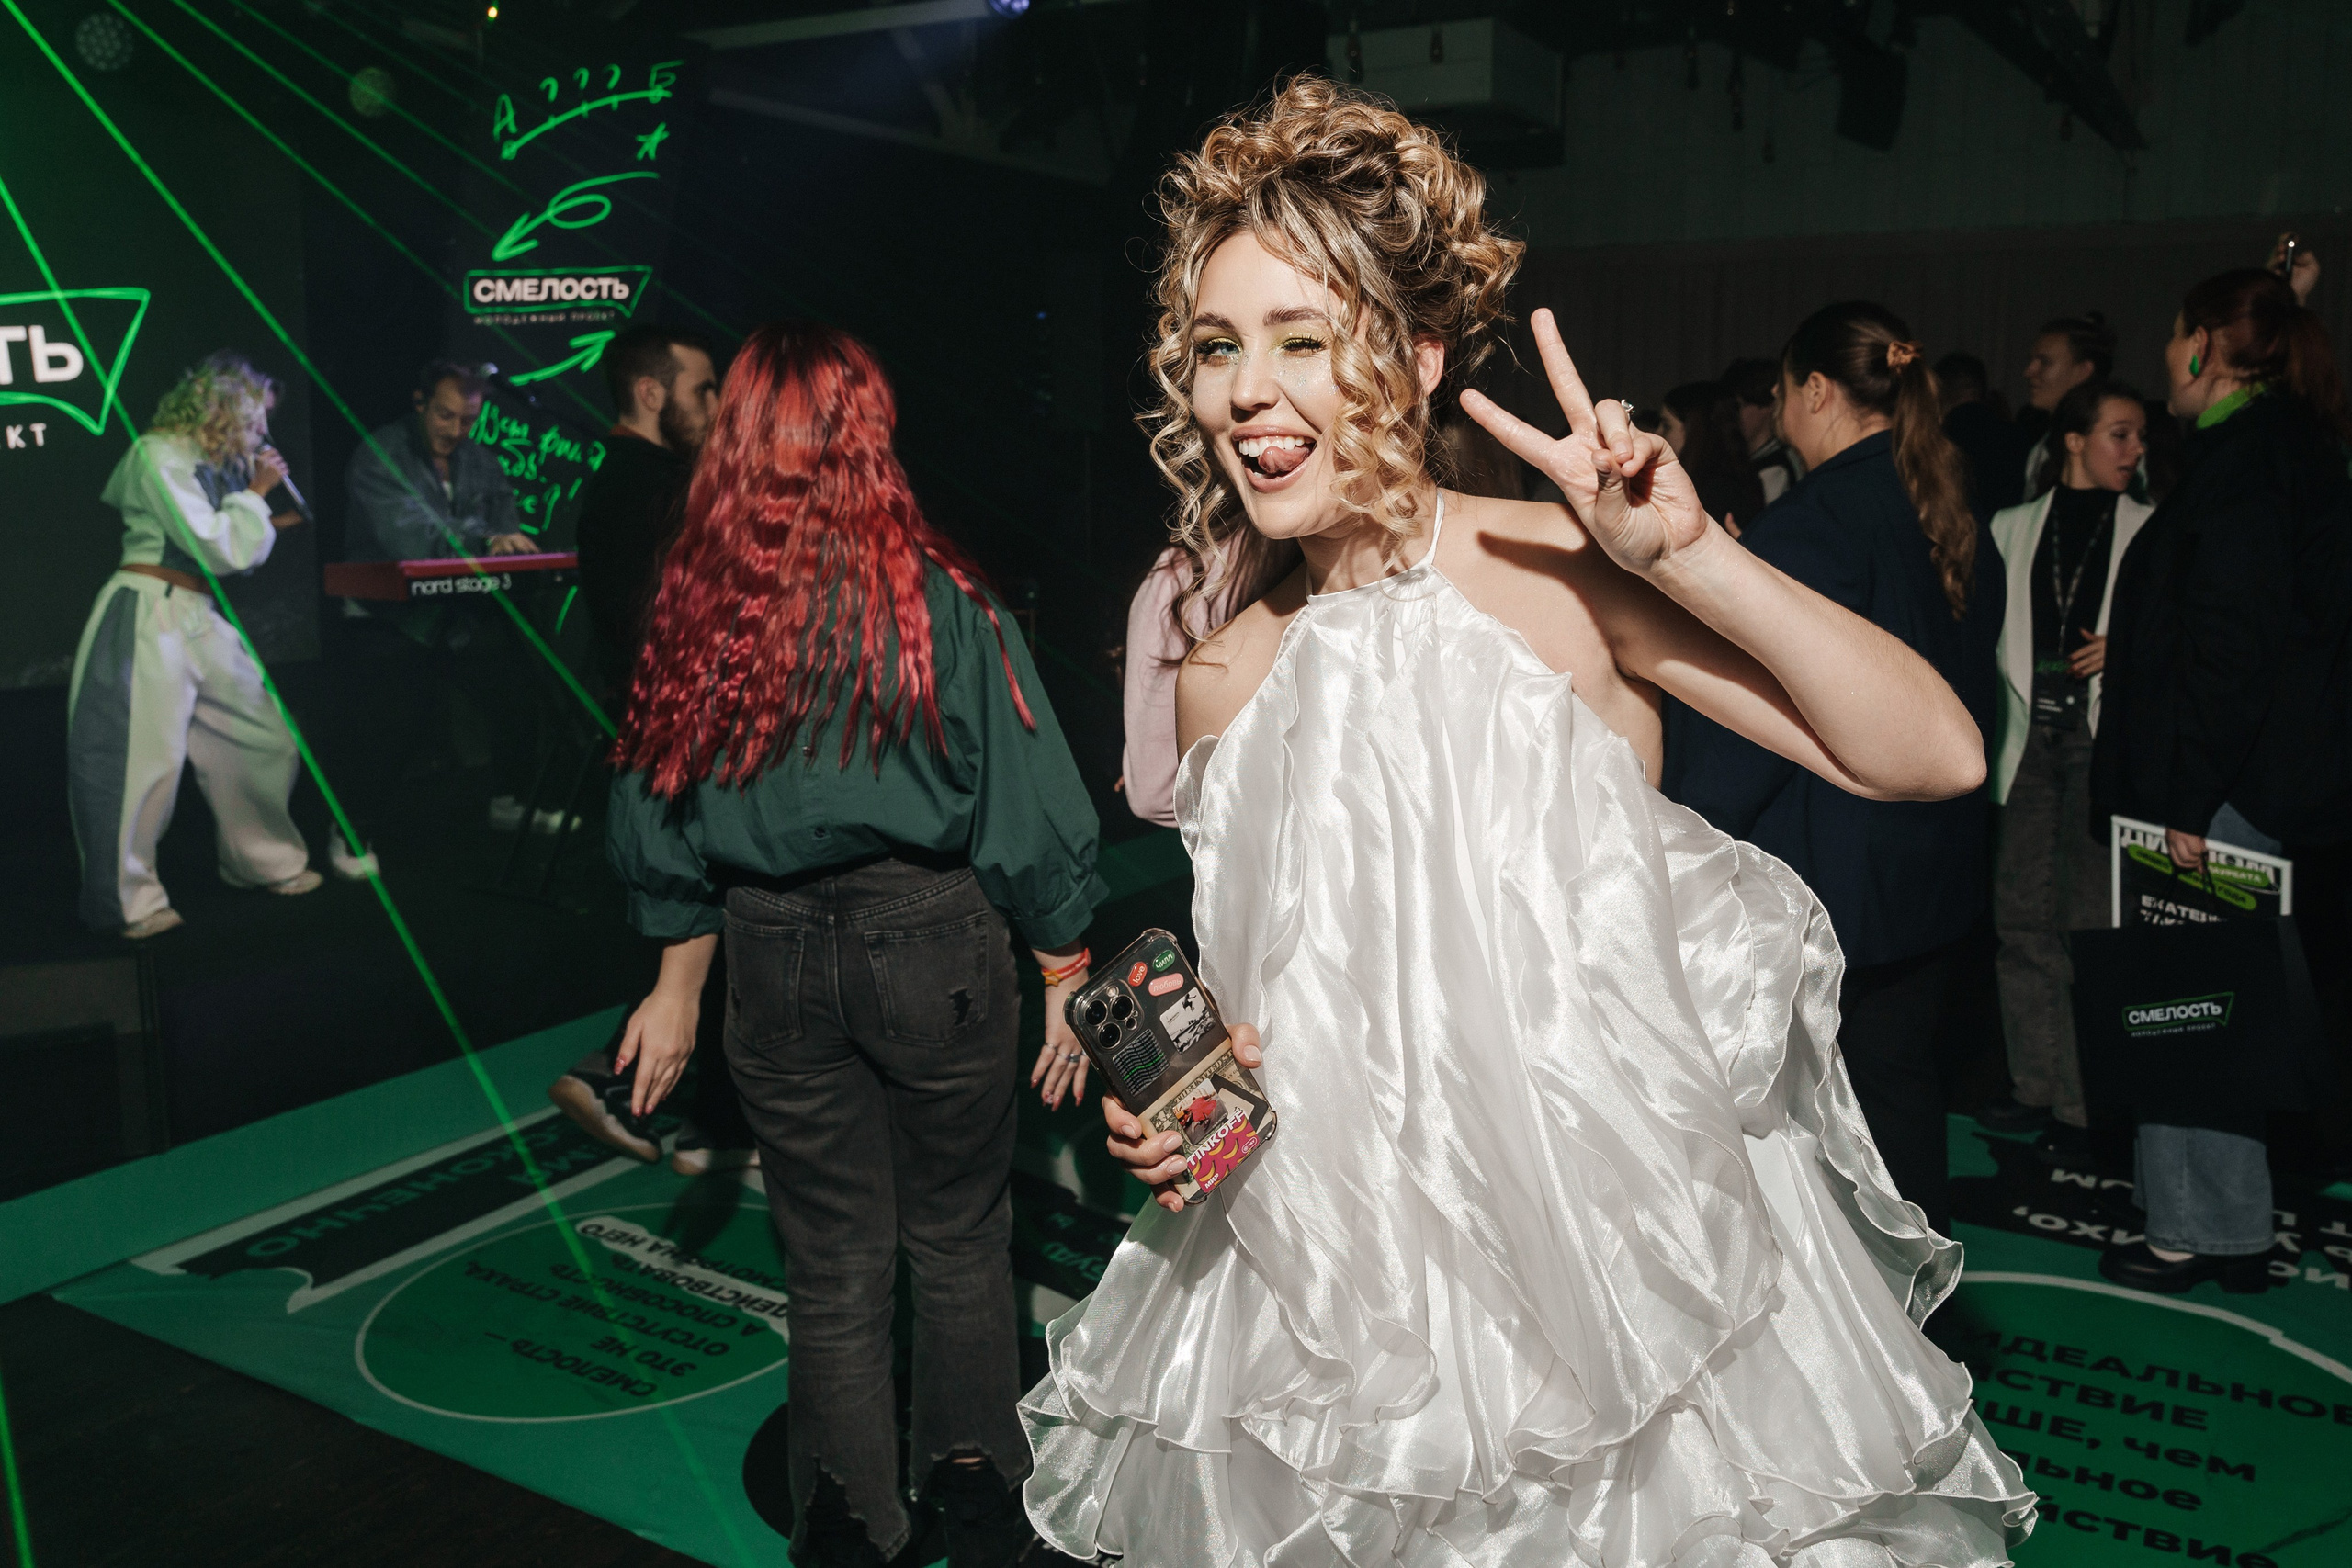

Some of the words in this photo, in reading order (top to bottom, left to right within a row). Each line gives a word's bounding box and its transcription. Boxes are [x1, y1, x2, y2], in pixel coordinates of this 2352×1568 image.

[473, 277, 630, 303] СМЕЛОСТЬ
[0, 325, 84, 385] ТЬ
[6, 423, 47, 450] КТ
[411, 579, 453, 596] nord
[456, 575, 500, 595] stage
[502, 572, 512, 590] 3
[1155, 953, 1174, 968] чилл
[1132, 965, 1146, 984] love
[1152, 978, 1182, 992] любовь
[2128, 1001, 2222, 1025] СМЕЛОСТЬ
[1186, 1111, 1247, 1167] TINKOFF
[1204, 1172, 1220, 1190] МИР
[581, 1223, 647, 1248] НЕГО
[741, 1322, 766, 1337] А
[590, 1337, 638, 1359] НЕ
[511, 1338, 658, 1397] СМЕЛОСТЬ
[636, 1349, 696, 1376] ЭТО
